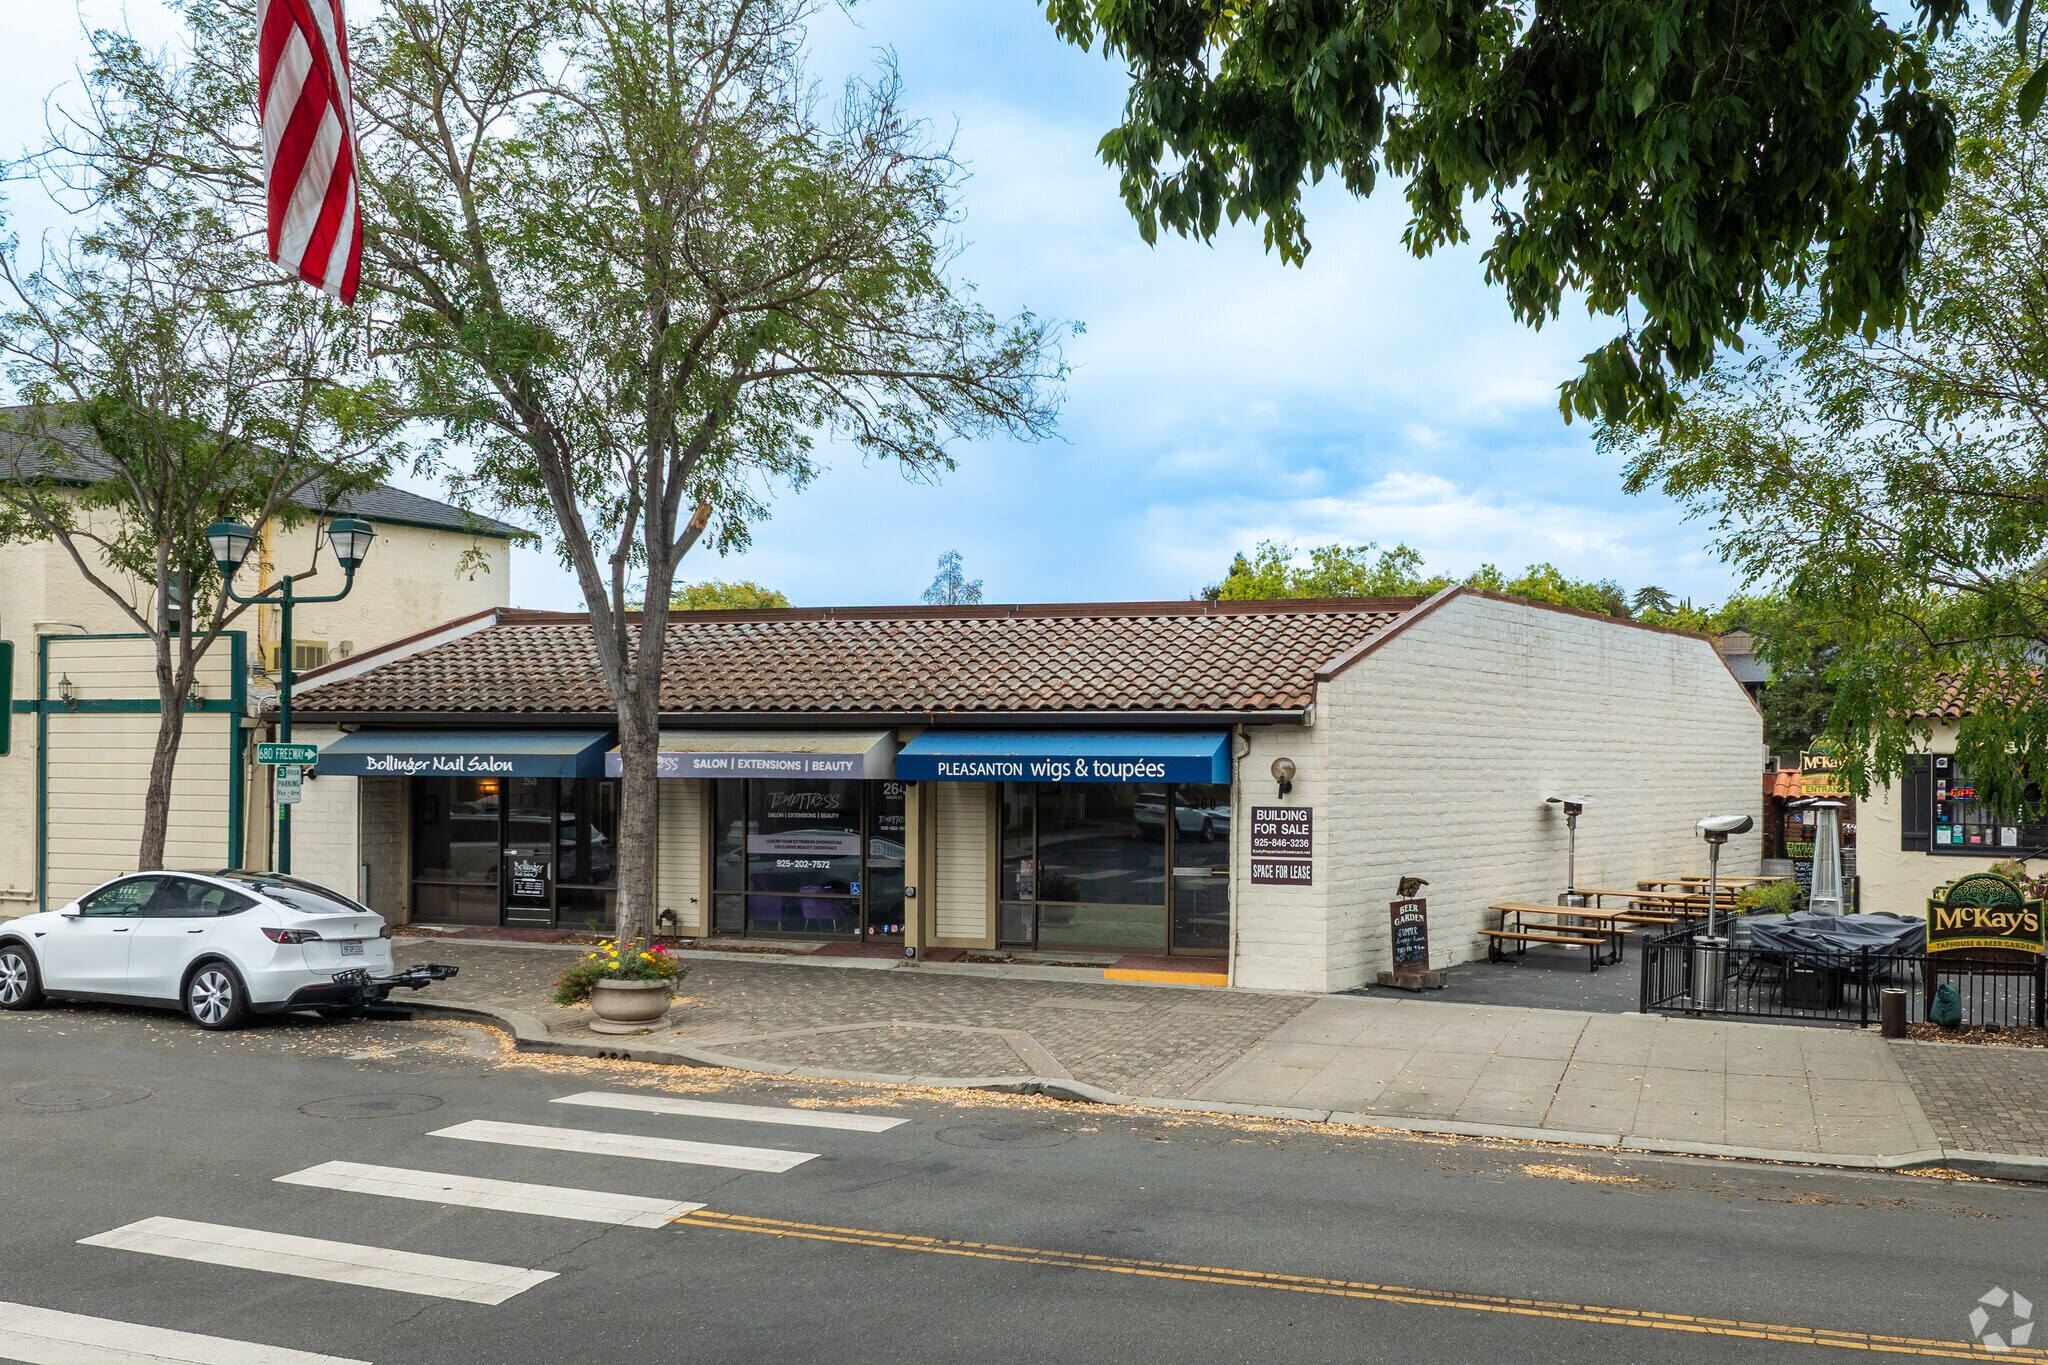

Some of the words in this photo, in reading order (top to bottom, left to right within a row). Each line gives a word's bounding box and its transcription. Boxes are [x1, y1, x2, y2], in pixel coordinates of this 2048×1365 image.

[260, 747, 273, 760] 680
[275, 748, 305, 760] FREEWAY
[366, 755, 430, 775] Bollinger
[433, 756, 464, 772] Nail
[467, 755, 513, 772] Salon
[693, 758, 727, 769] SALON
[737, 759, 801, 772] EXTENSIONS
[812, 760, 853, 772] BEAUTY
[1804, 755, 1847, 771] McKay
[279, 768, 285, 777] 3
[938, 762, 1022, 776] PLEASANTON
[1030, 758, 1070, 781] wigs
[1075, 759, 1088, 777] &
[1093, 758, 1165, 781] toupées
[278, 780, 299, 788] PARKING
[522, 777, 537, 786] 268
[1806, 785, 1849, 793] ENTRANE
[768, 792, 840, 809] TEMPTTRESS
[1193, 798, 1216, 810] 260
[1256, 810, 1307, 821] BUILDING
[1254, 823, 1277, 834] FOR
[1281, 823, 1309, 835] SALE
[1254, 838, 1309, 848] 925-846-3236
[1787, 849, 1814, 858] WELCO
[776, 860, 830, 868] 925-202-7572
[1252, 864, 1273, 878] SPACE
[1275, 865, 1288, 878] FOR
[1290, 865, 1310, 879] LEASE
[1399, 904, 1418, 915] BEER
[1394, 914, 1424, 926] GARDEN
[1934, 908, 2038, 935] McKay's
[1398, 927, 1418, 937] SUMMER
[1936, 940, 1974, 949] TAPHOUSE
[2005, 942, 2036, 950] GARDEN
